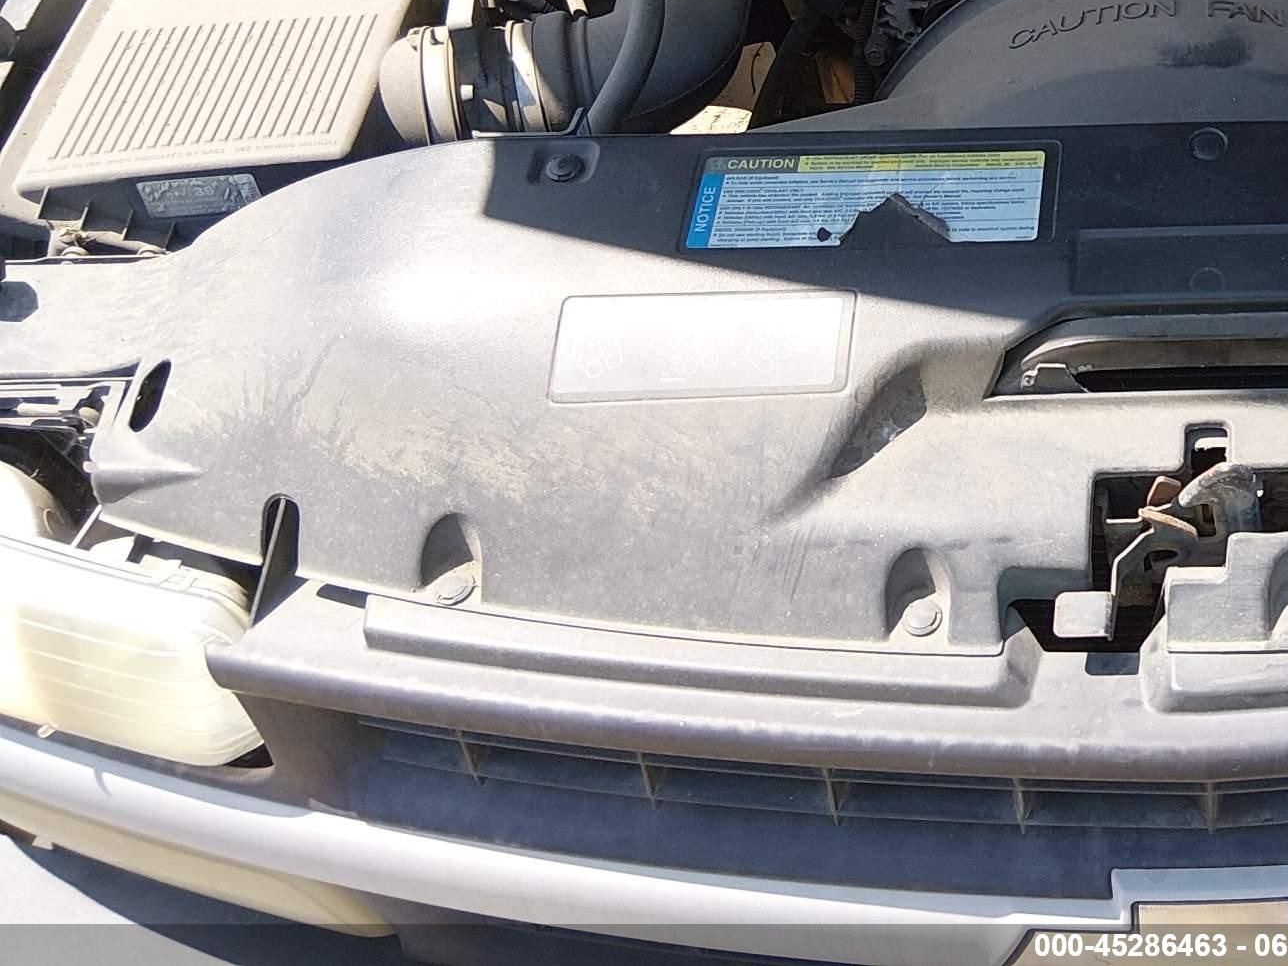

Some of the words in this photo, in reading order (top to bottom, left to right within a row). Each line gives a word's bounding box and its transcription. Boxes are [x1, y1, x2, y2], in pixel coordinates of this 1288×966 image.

[1008, 0, 1178, 50] CAUTION
[1207, 0, 1286, 27] FAN
[727, 158, 795, 170] CAUTION
[694, 186, 717, 234] NOTICE
